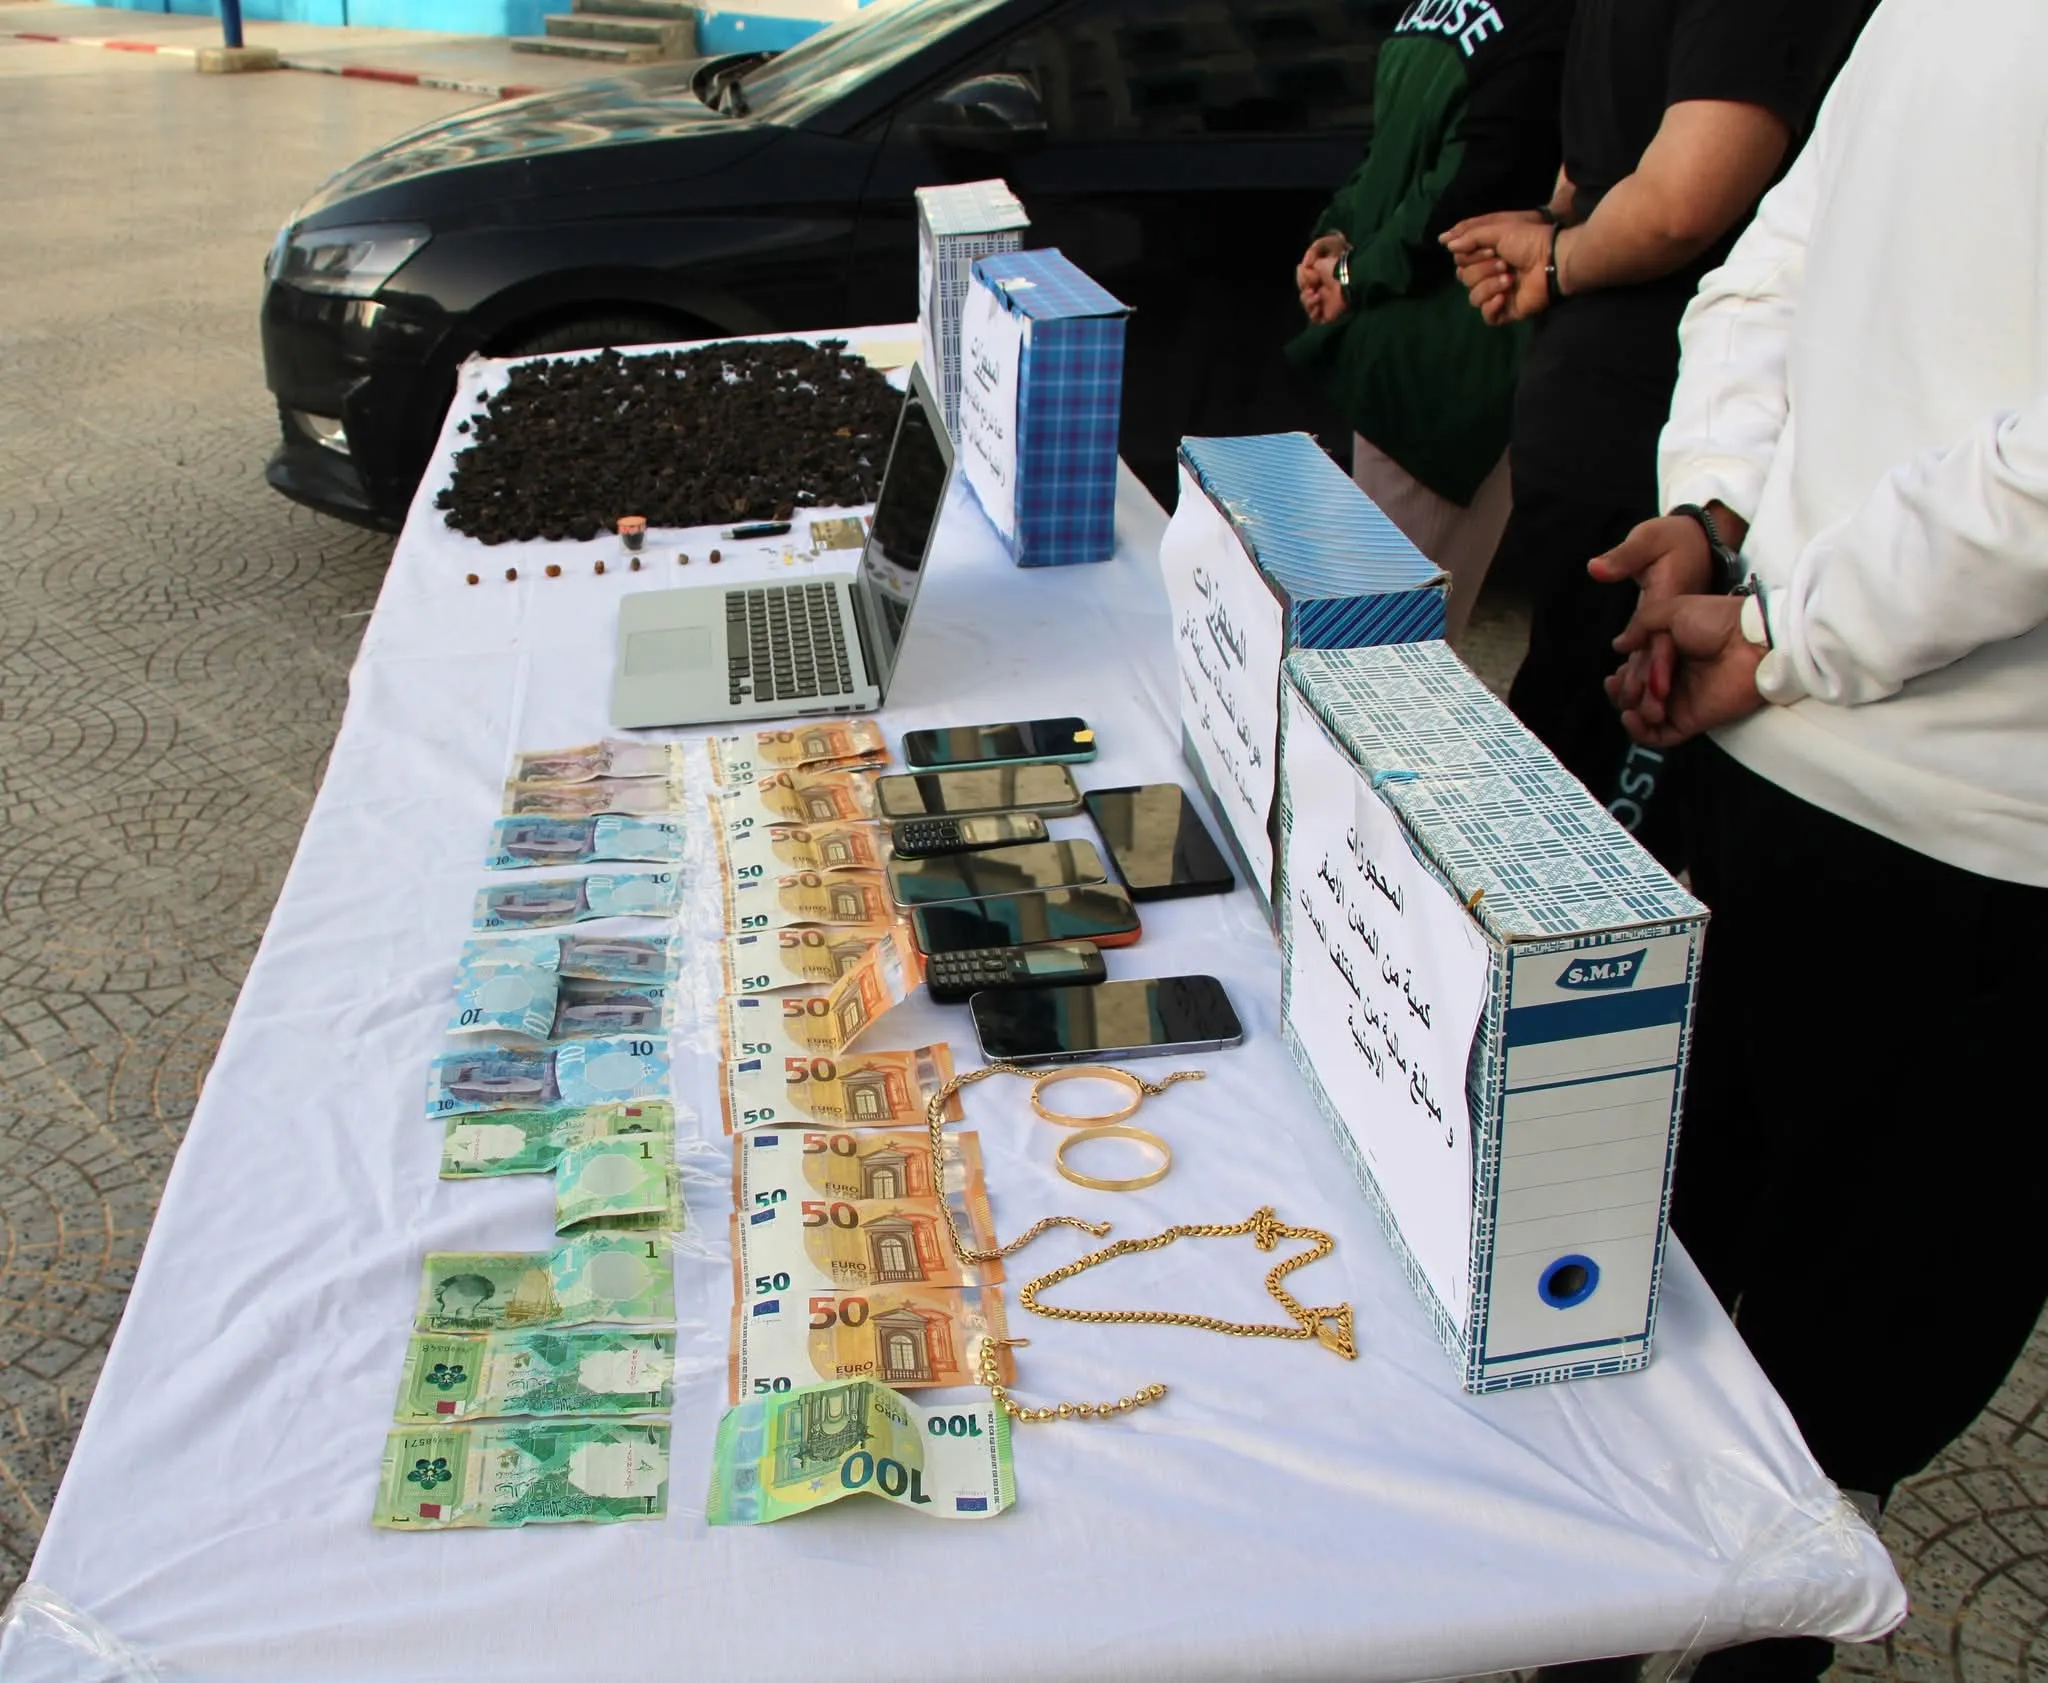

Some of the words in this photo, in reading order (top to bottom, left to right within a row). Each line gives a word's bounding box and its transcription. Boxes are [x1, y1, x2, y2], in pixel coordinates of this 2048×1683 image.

[1193, 567, 1246, 672] المحجوزات
[658, 824, 677, 833] 10
[730, 817, 754, 831] 50
[770, 828, 812, 843] 50
[651, 873, 672, 884] 10
[737, 864, 763, 879] 50
[1346, 824, 1404, 916] المحجوزات
[778, 873, 822, 889] 50
[741, 914, 768, 929] 50
[1300, 888, 1327, 949] العملات
[778, 930, 825, 949] 50
[1347, 901, 1379, 960] المعدن
[1329, 942, 1360, 1002] مختلف
[1382, 952, 1399, 988] من
[1568, 960, 1633, 984] S.M.P
[742, 975, 770, 990] 50
[783, 998, 830, 1018] 50
[1403, 970, 1431, 1031] كمية
[460, 1008, 483, 1025] 10
[1364, 999, 1379, 1027] من
[630, 1040, 653, 1056] 10
[742, 1042, 772, 1054] 50
[1348, 1003, 1384, 1084] الاجنبية
[1383, 1011, 1406, 1074] مالية
[785, 1057, 836, 1084] 50
[1409, 1063, 1442, 1123] مبالغ
[437, 1099, 454, 1111] 10
[744, 1107, 775, 1124] 50
[803, 1133, 857, 1158] 50
[1444, 1127, 1453, 1148] و
[639, 1141, 652, 1159] 1
[755, 1188, 788, 1208] 50
[825, 1182, 859, 1194] EURO
[802, 1201, 859, 1229] 50
[645, 1240, 659, 1258] 1
[831, 1260, 867, 1271] EURO
[755, 1272, 791, 1295] 50
[809, 1297, 869, 1330] 50
[836, 1361, 874, 1375] EURO
[754, 1376, 792, 1395] 50
[874, 1402, 909, 1428] EURO
[927, 1414, 984, 1438] 100
[840, 1451, 932, 1504] 100
